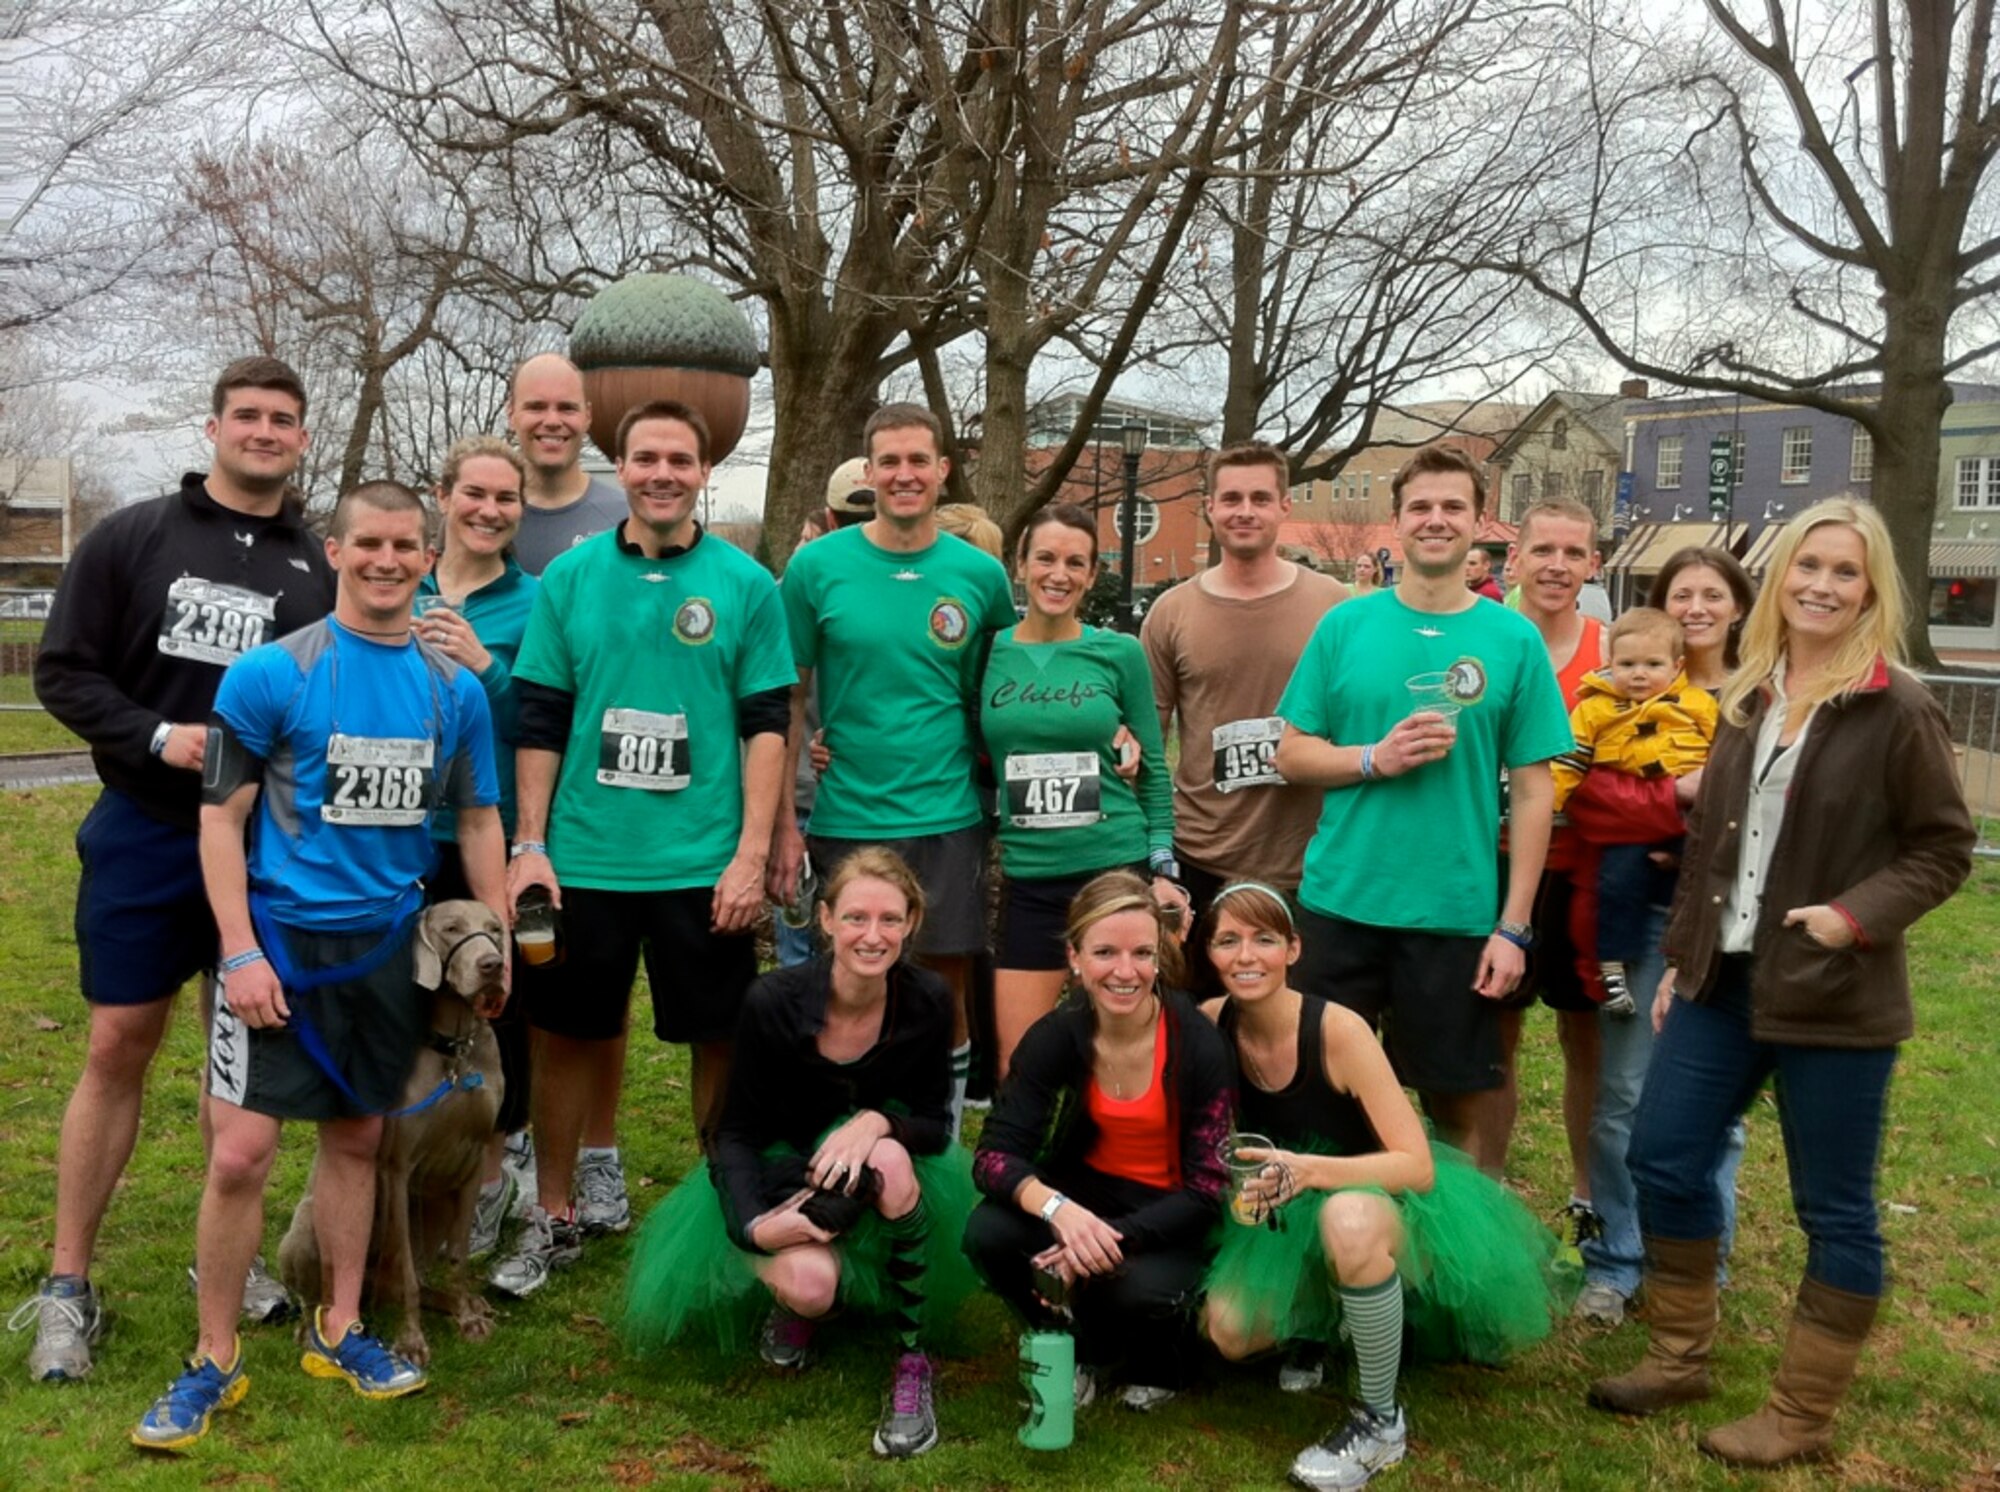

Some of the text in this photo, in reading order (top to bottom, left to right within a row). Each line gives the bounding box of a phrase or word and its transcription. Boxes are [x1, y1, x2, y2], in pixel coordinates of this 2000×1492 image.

[171, 600, 264, 653] 2380
[990, 680, 1097, 708] Chiefs
[617, 733, 675, 776] 801
[1225, 741, 1276, 778] 959
[333, 766, 423, 809] 2368
[1025, 777, 1080, 814] 467
